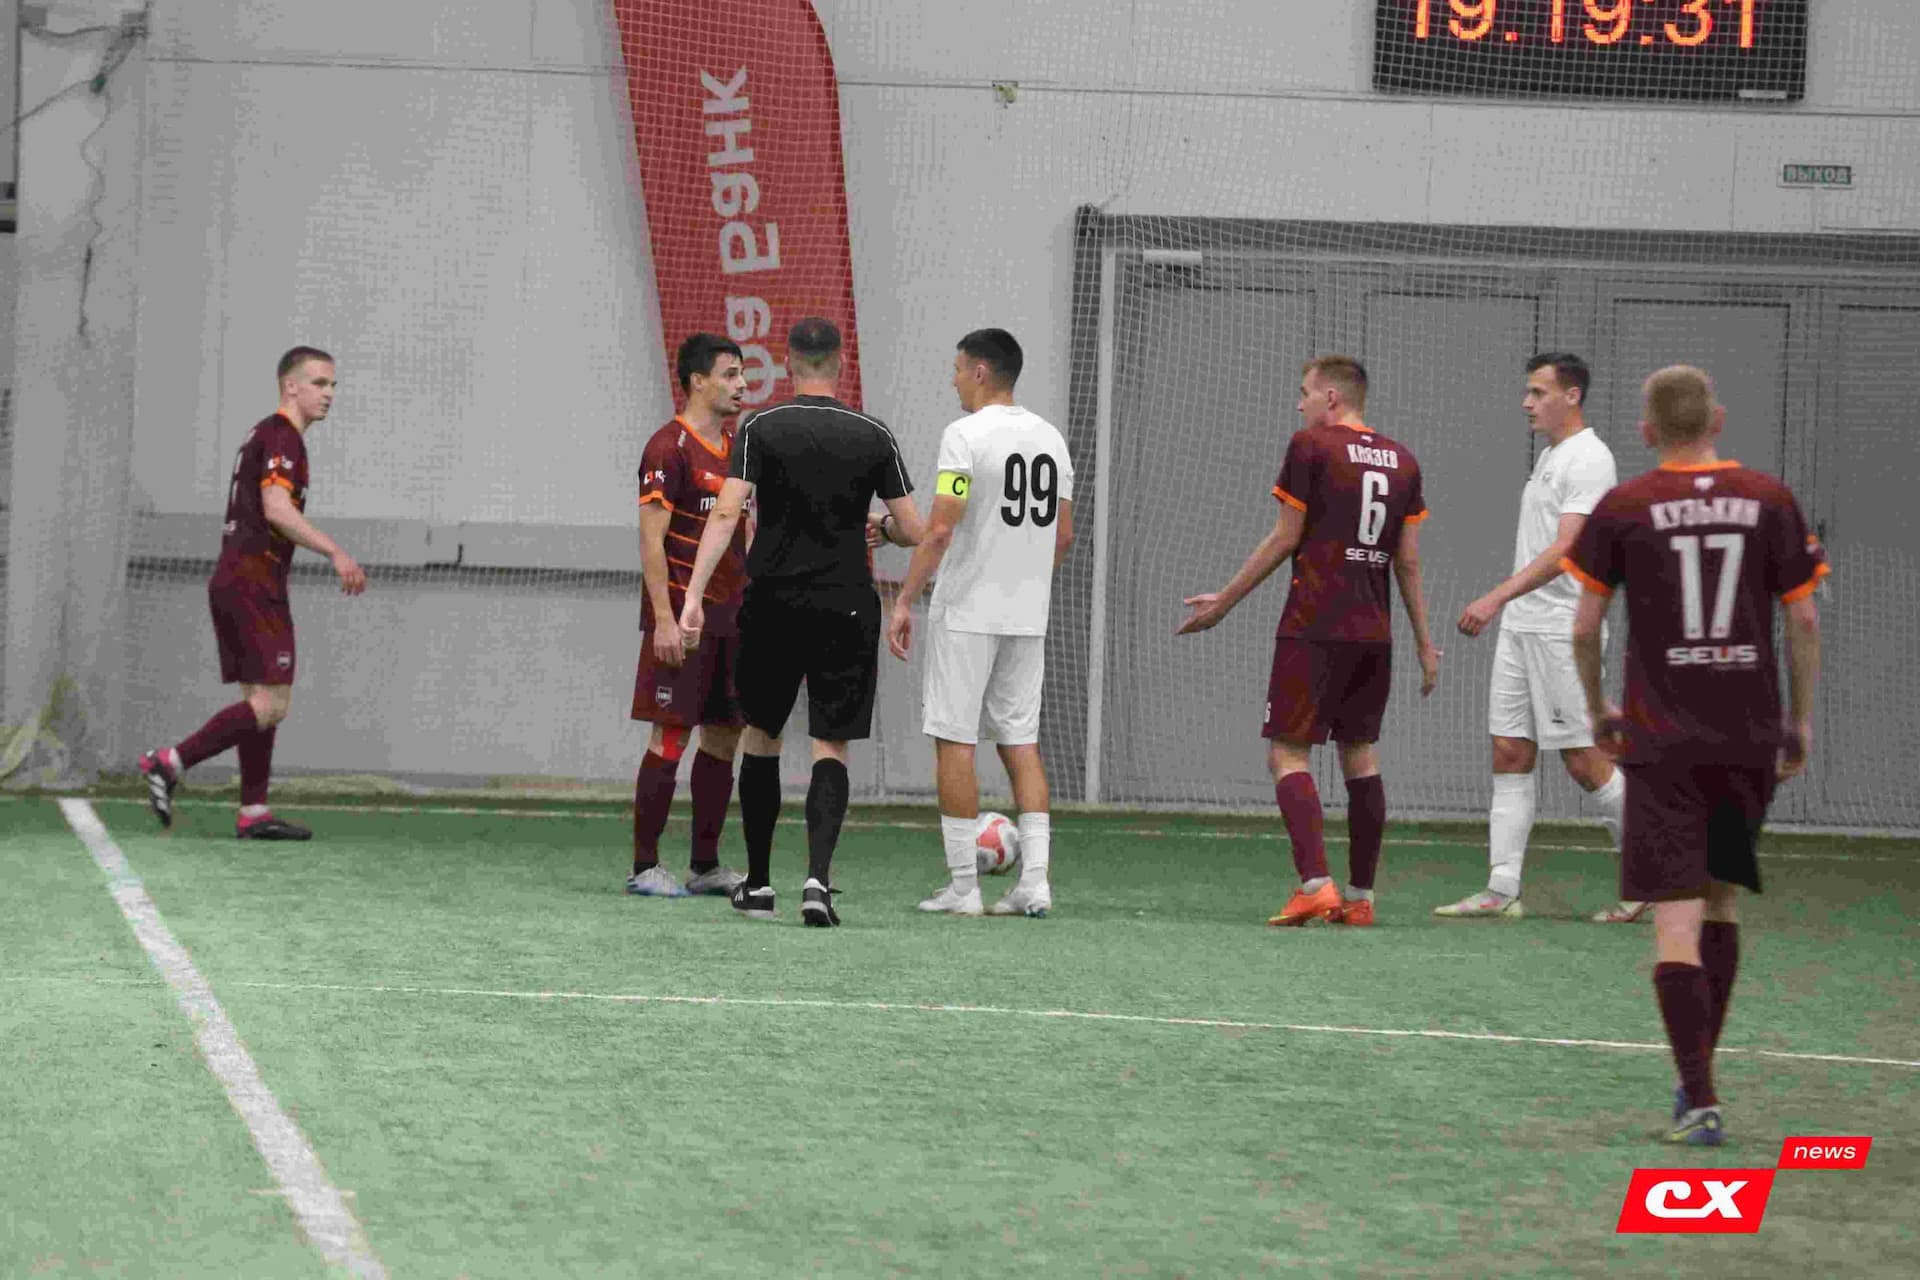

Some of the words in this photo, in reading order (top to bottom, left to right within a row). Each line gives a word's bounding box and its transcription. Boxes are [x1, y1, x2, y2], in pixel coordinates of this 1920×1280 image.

[1784, 165, 1851, 184] ВЫХОД
[1346, 443, 1399, 469] КНЯЗЕВ
[952, 476, 967, 496] C
[1001, 453, 1058, 528] 99
[1357, 470, 1389, 546] 6
[1650, 497, 1761, 531] КУЗЬКИН
[1669, 533, 1746, 640] 17
